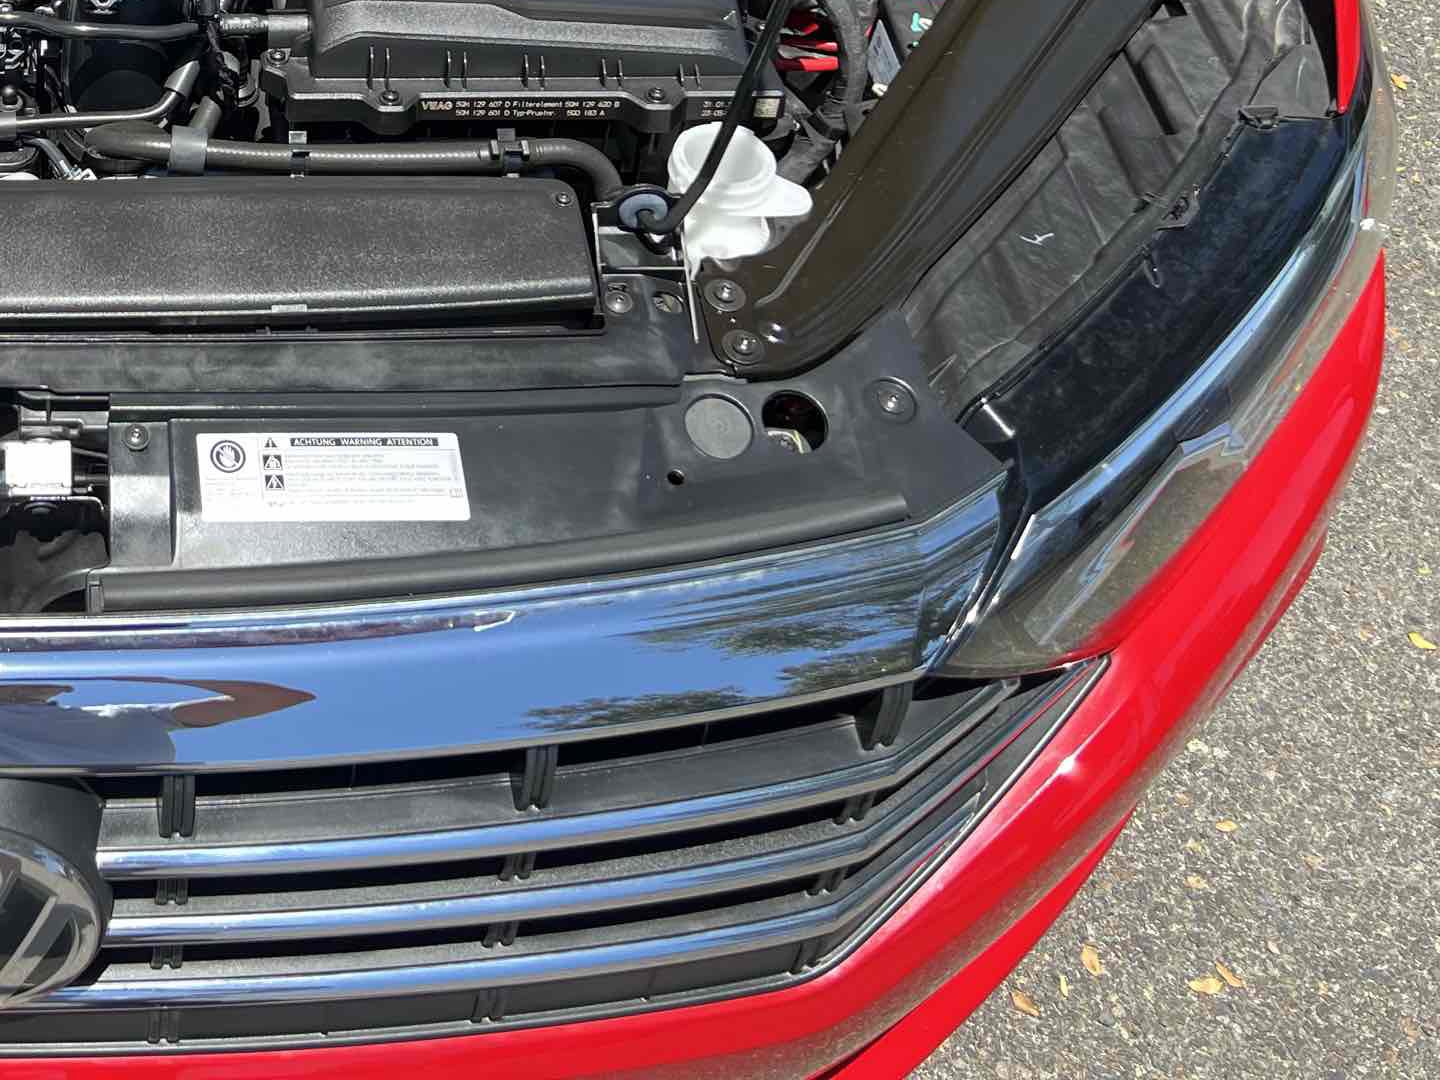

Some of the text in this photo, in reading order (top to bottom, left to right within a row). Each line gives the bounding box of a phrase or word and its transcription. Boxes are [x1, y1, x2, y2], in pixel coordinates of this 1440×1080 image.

[293, 437, 433, 446] ACHTUNG WARNING ATTENTION
